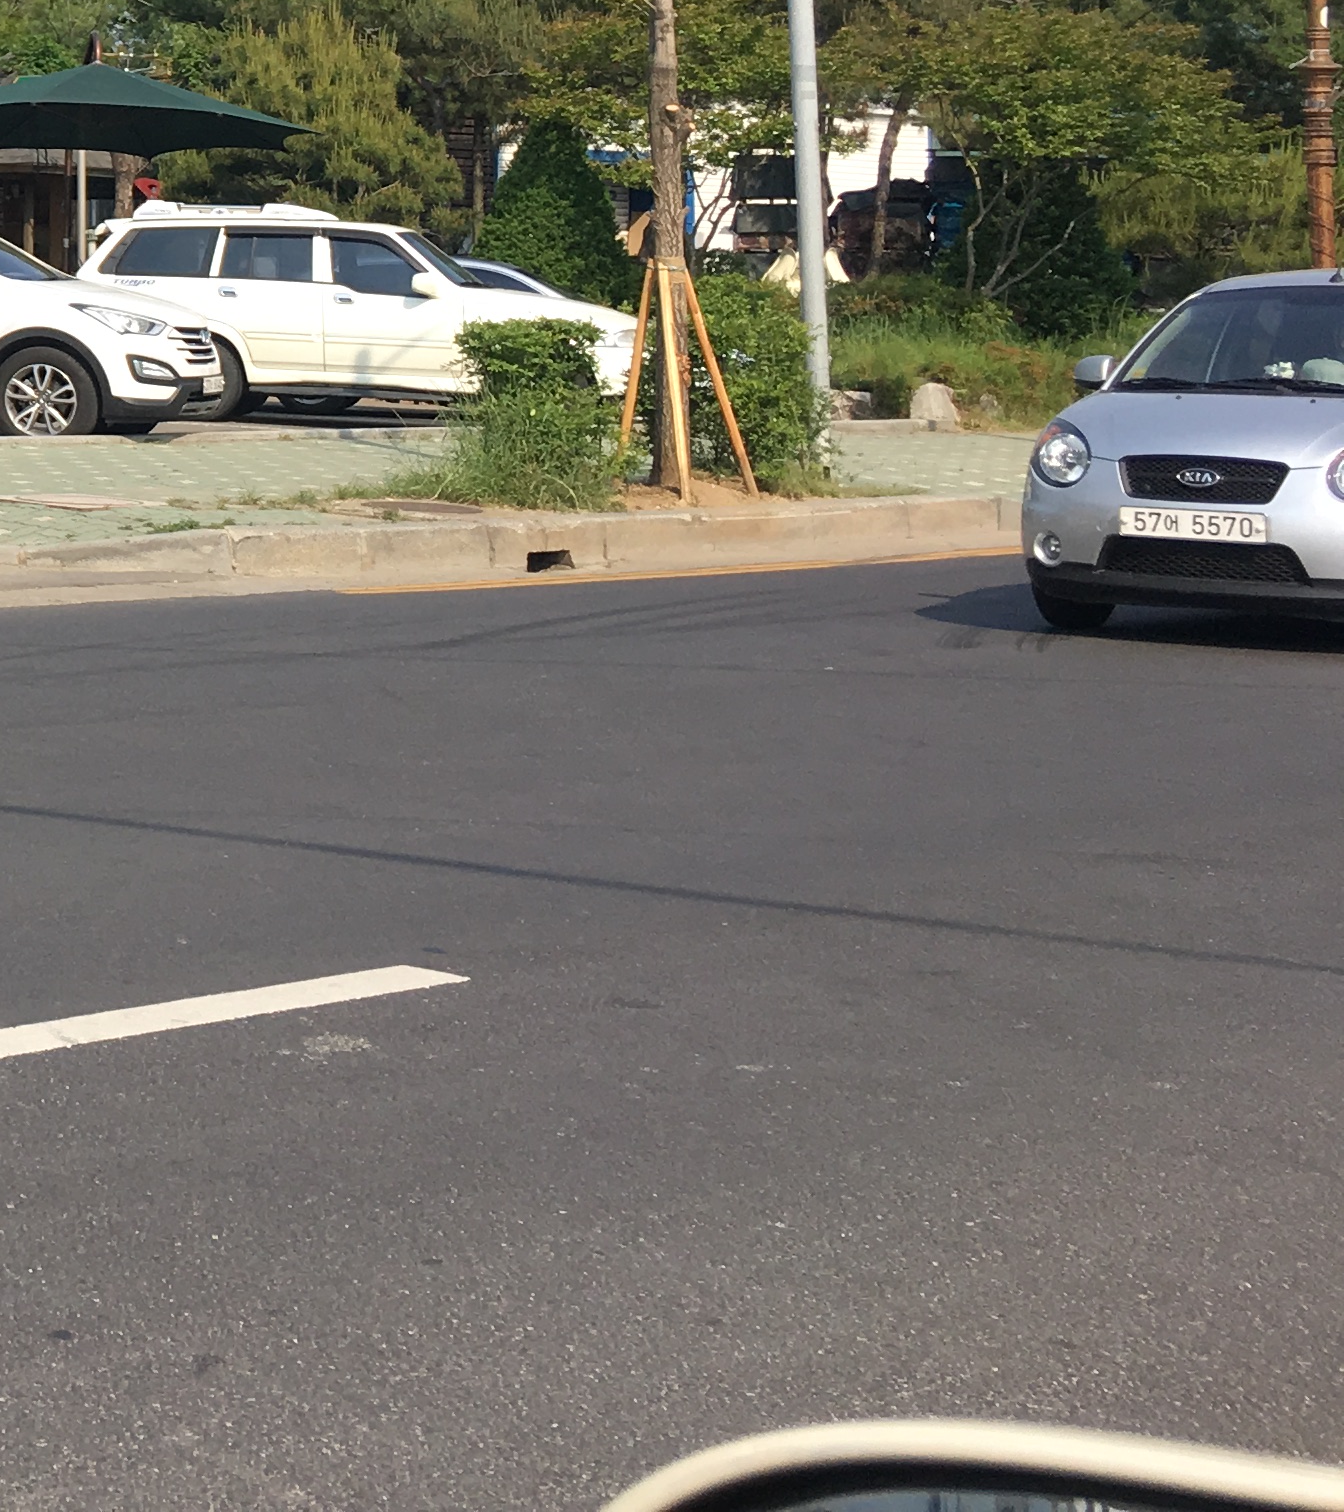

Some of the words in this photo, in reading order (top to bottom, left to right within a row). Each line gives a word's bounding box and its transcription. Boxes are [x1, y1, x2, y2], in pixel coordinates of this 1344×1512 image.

[1183, 471, 1213, 483] KIA
[1133, 510, 1179, 533] 57어
[1191, 514, 1254, 539] 5570
